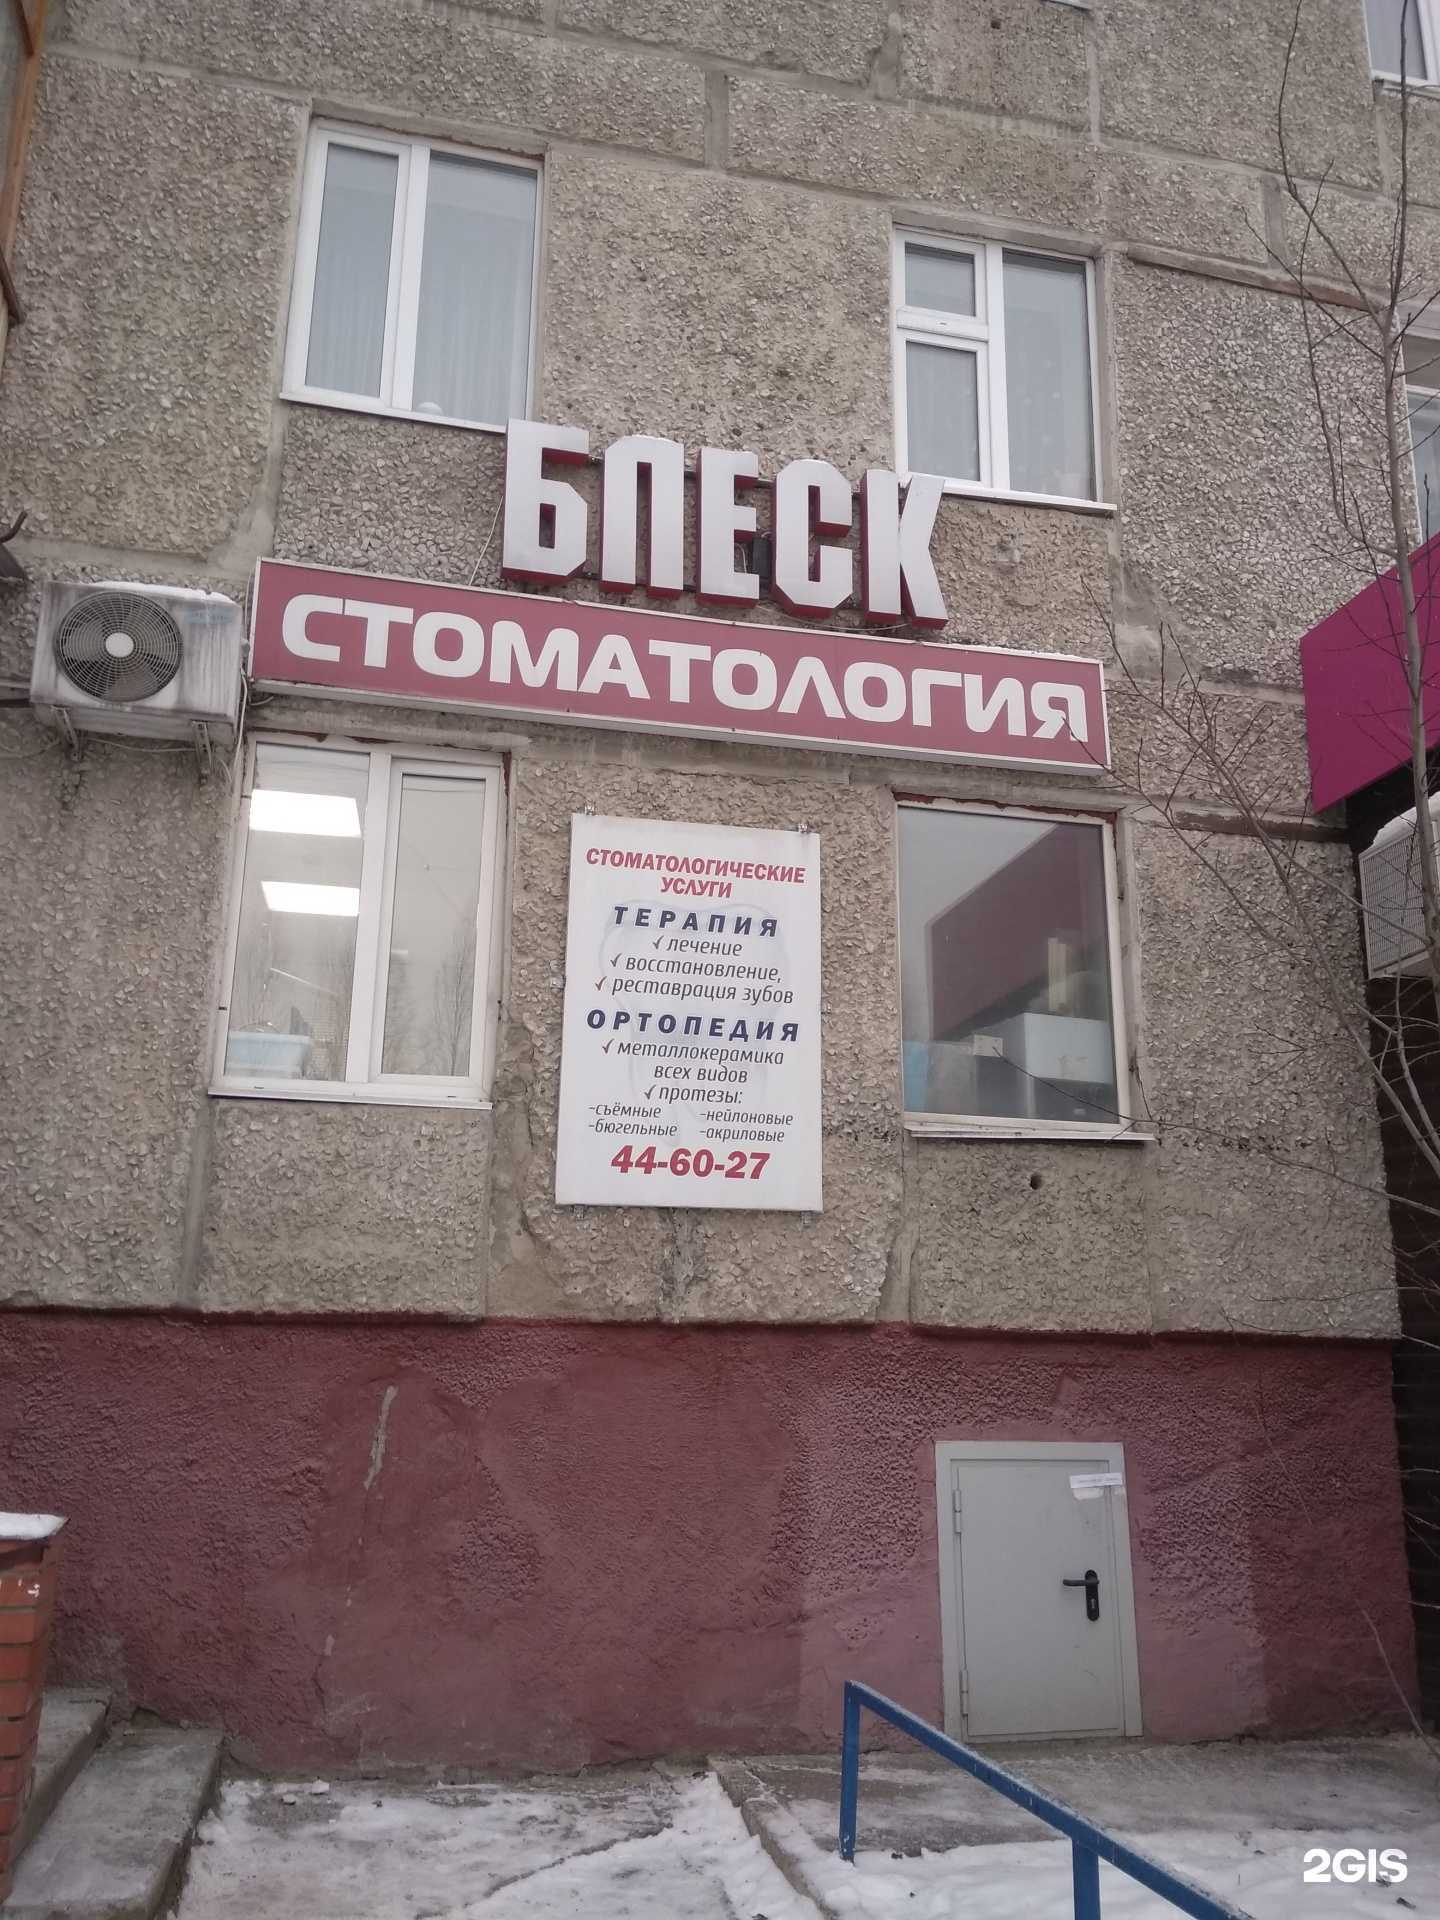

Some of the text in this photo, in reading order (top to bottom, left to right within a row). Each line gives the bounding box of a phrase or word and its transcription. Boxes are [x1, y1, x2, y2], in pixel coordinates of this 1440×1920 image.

[281, 594, 1088, 743] СТОМАТОЛОГИЯ
[586, 847, 806, 884] СТОМАТОЛОГИЧЕСКИЕ
[660, 876, 733, 899] УСЛУГИ
[613, 906, 778, 938] ТЕРАПИЯ
[666, 937, 743, 957] лечение
[625, 956, 782, 984] восстановление,
[611, 976, 794, 1005] реставрация зубов
[586, 1008, 799, 1043] ОРТОПЕДИЯ
[617, 1040, 785, 1066] металлокерамика
[653, 1065, 749, 1084] всех видов
[658, 1085, 743, 1105] протезы:
[611, 1144, 771, 1180] 44-60-27
